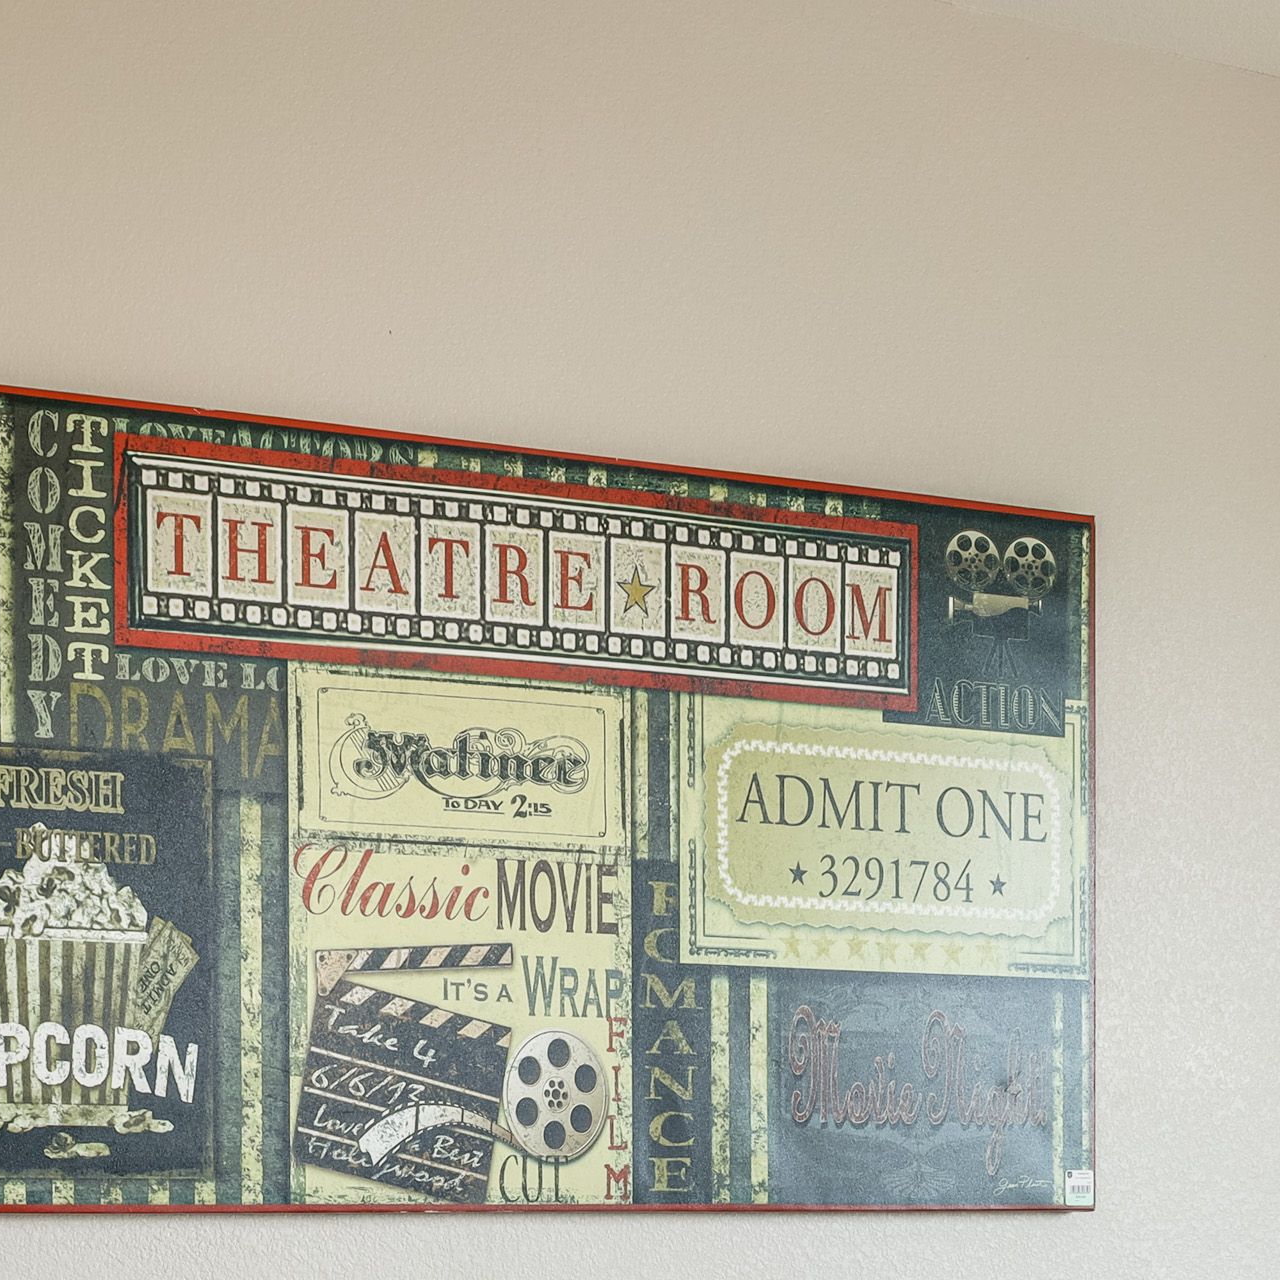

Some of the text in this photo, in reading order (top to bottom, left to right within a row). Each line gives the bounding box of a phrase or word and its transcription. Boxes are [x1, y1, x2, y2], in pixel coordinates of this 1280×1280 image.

[24, 409, 64, 739] COMEDY
[65, 412, 111, 681] TICKET
[156, 511, 893, 643] THEATRE ROOM
[114, 653, 228, 689] LOVE
[925, 676, 1063, 735] ACTION
[69, 682, 286, 778] DRAMA
[346, 727, 589, 793] Matinee
[510, 794, 552, 818] 2:15
[735, 771, 1048, 843] ADMIT ONE
[293, 843, 619, 936] Classic MOVIE
[818, 853, 974, 903] 3291784
[442, 955, 624, 1018] IT'S A WRAP
[324, 1004, 437, 1068] Take 4
[604, 1016, 629, 1200] FILM
[788, 1005, 1048, 1177] Movie Night
[498, 1153, 569, 1204] CUT
